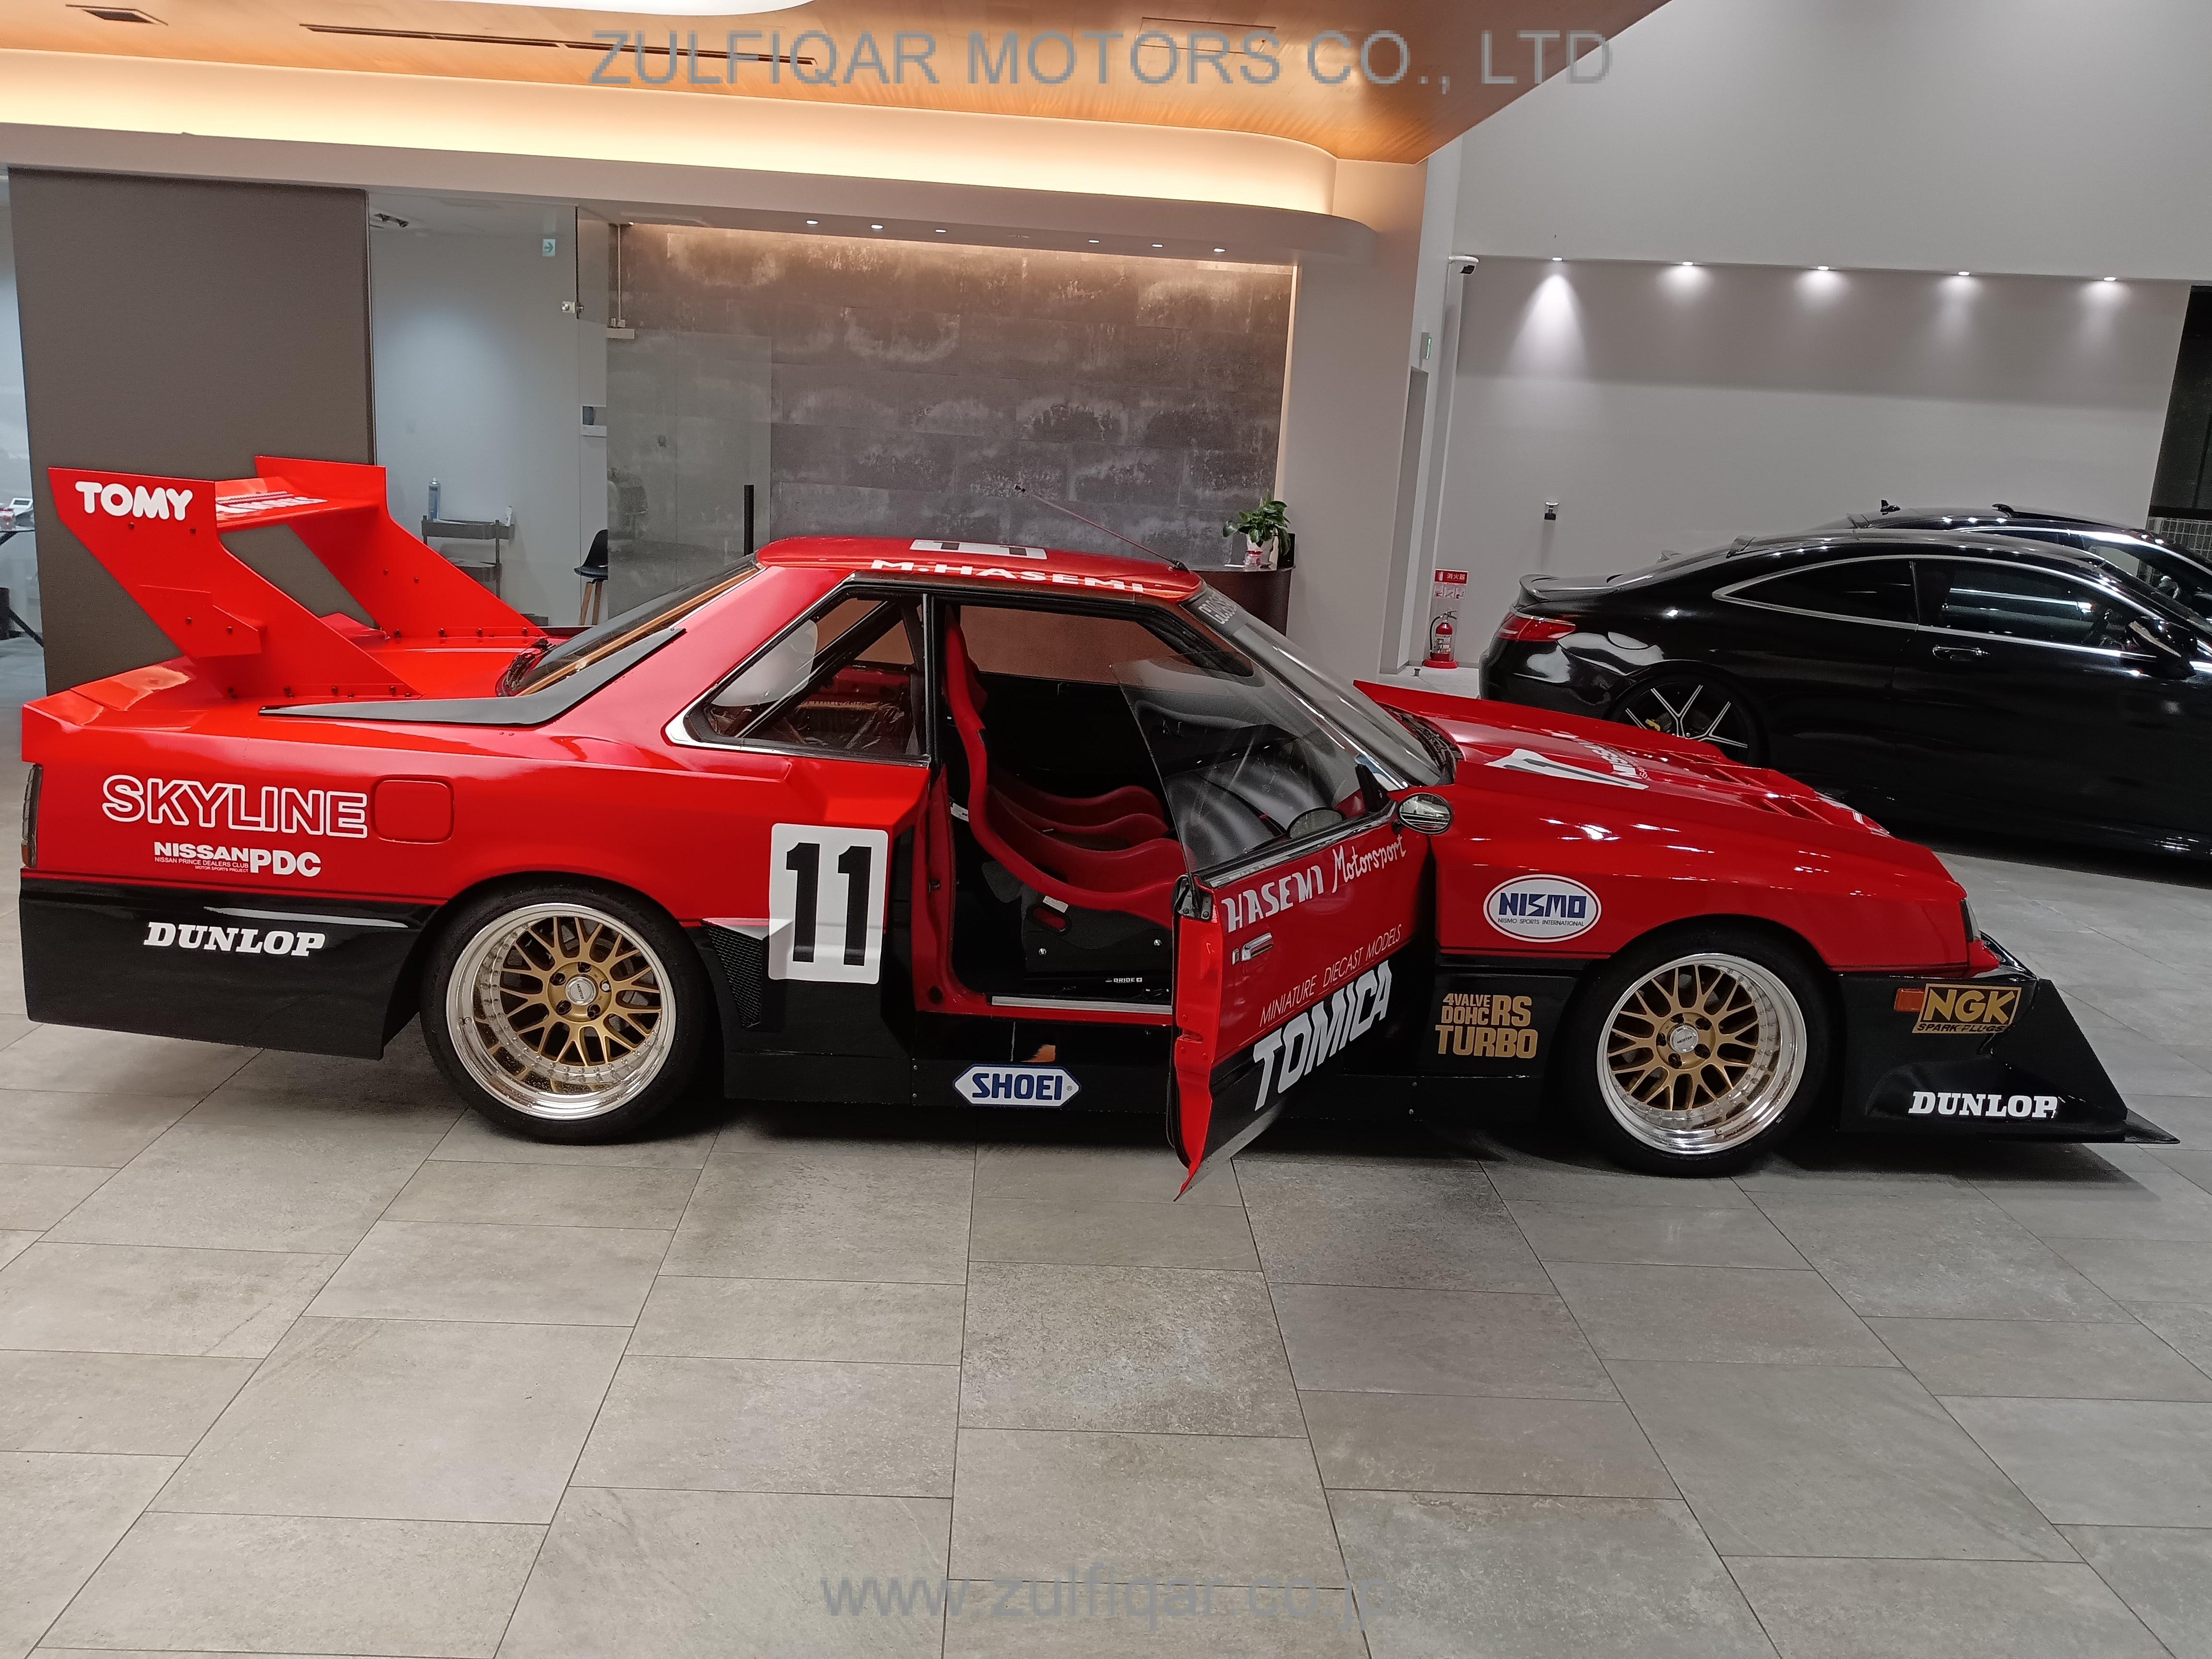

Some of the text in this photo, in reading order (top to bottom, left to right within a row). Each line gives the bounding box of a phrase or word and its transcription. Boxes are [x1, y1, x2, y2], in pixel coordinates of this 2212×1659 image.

[75, 481, 193, 521] TOMY
[101, 774, 368, 839] SKYLINE
[154, 841, 321, 877] NISSAN PDC
[1221, 834, 1407, 933] HASEMI Motorsport
[785, 842, 872, 967] 11
[1498, 892, 1587, 919] NISMO
[144, 922, 325, 957] DUNLOP
[1260, 924, 1402, 1027] MINIATURE DIECAST MODELS
[1441, 1006, 1489, 1024] DOHC
[1443, 993, 1491, 1007] 4VALVE
[1491, 995, 1532, 1026] RS
[1923, 988, 2015, 1024] NGK
[1253, 960, 1392, 1111] TOMICA
[1435, 1025, 1538, 1059] TURBO
[1917, 1023, 1960, 1032] SPARK
[972, 1073, 1063, 1100] SHOEI
[1908, 1091, 2058, 1118] DUNLOP
